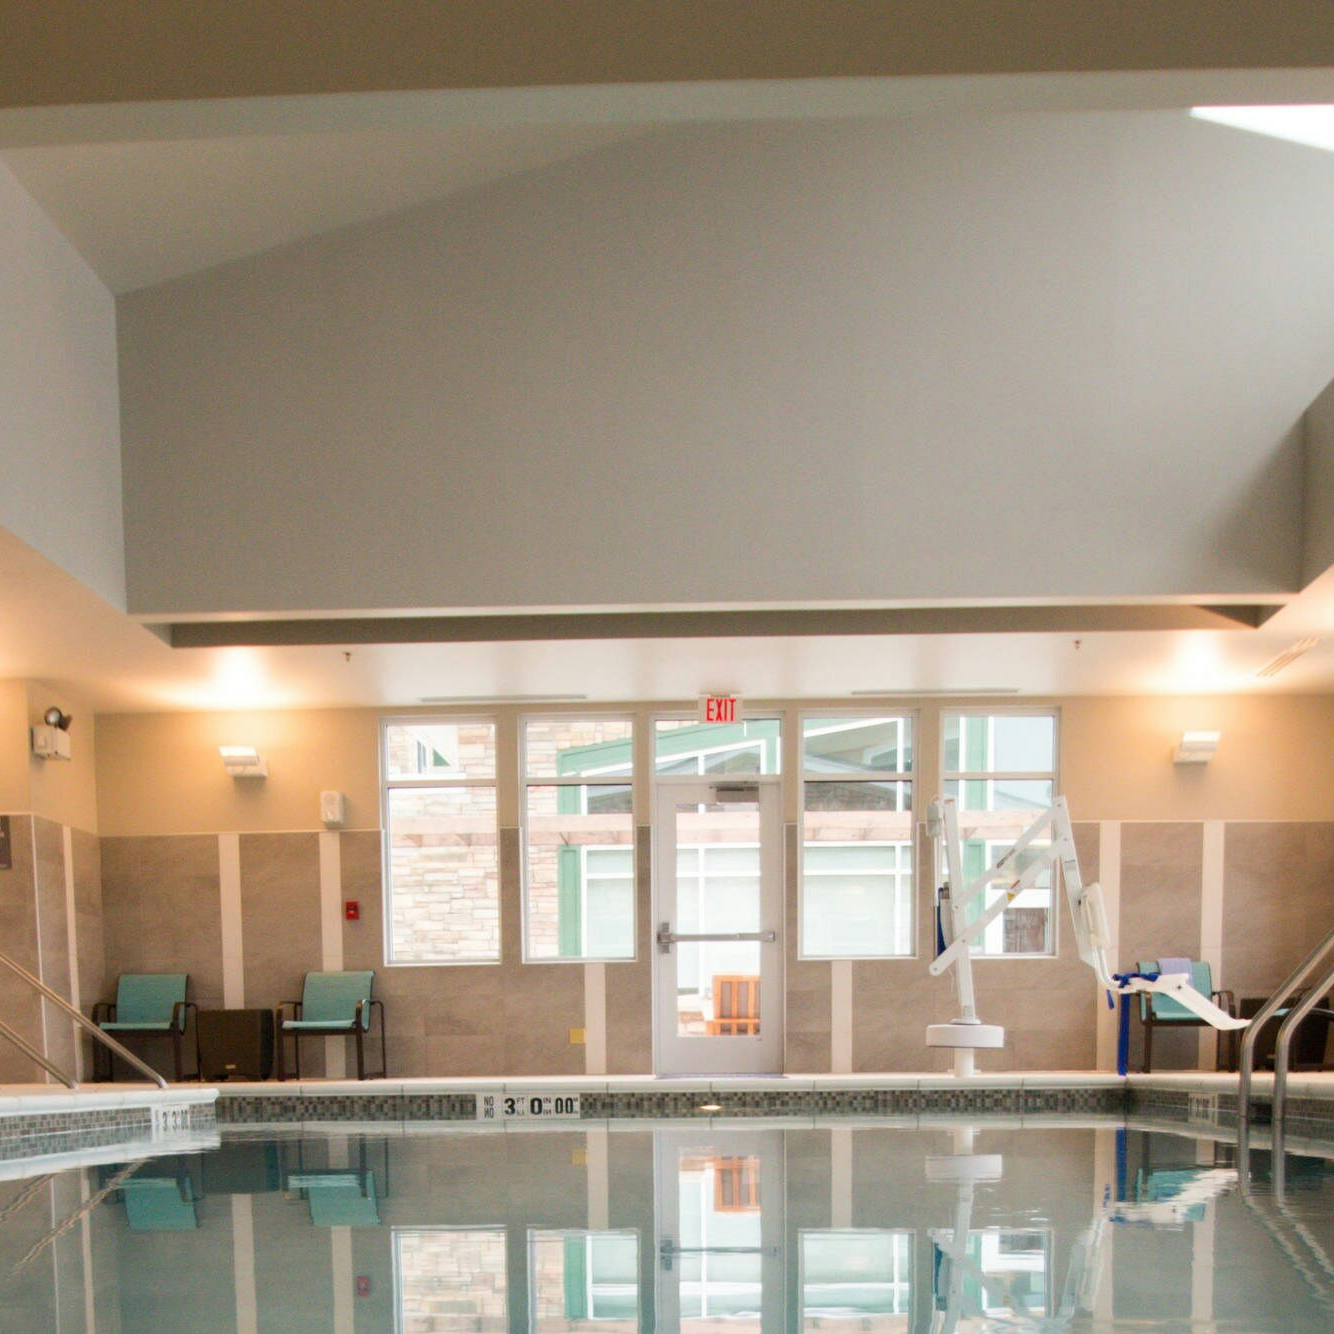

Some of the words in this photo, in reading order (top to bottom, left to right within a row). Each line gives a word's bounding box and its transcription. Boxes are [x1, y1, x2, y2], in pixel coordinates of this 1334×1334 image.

[706, 698, 737, 722] EXIT
[484, 1096, 494, 1107] NO
[504, 1098, 515, 1115] 3
